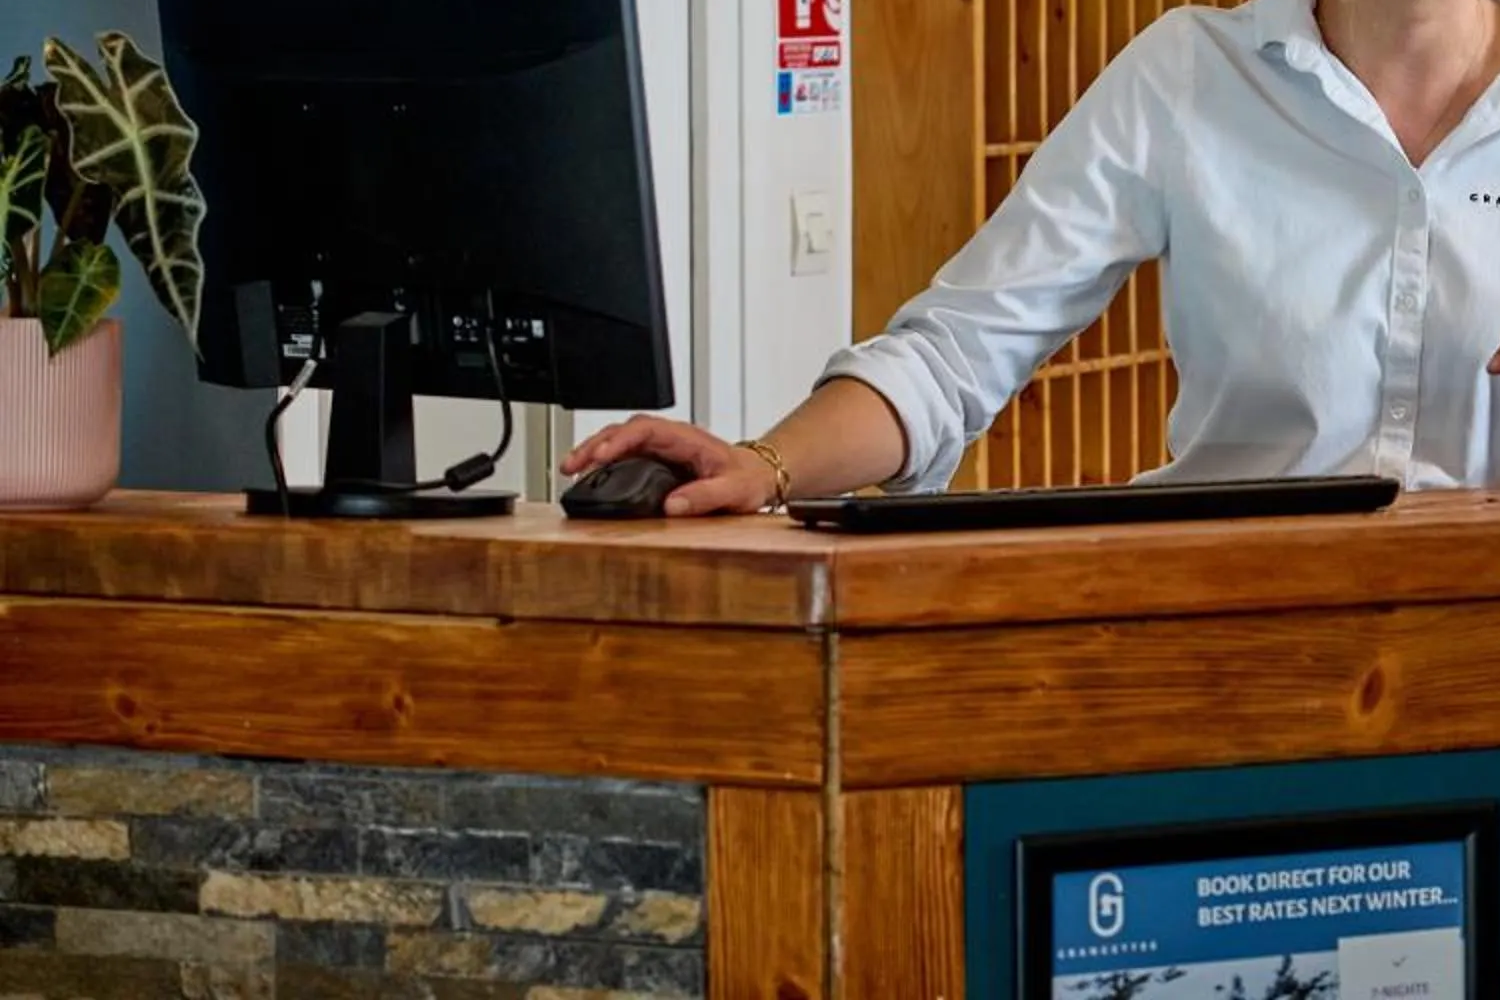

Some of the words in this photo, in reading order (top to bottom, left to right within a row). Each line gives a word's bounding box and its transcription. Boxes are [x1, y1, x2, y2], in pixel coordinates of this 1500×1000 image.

[1197, 874, 1254, 898] BOOK
[1256, 868, 1325, 893] DIRECT
[1328, 864, 1367, 887] FOR
[1369, 860, 1411, 882] OUR
[1197, 903, 1246, 927] BEST
[1248, 898, 1308, 923] RATES
[1311, 893, 1361, 918] NEXT
